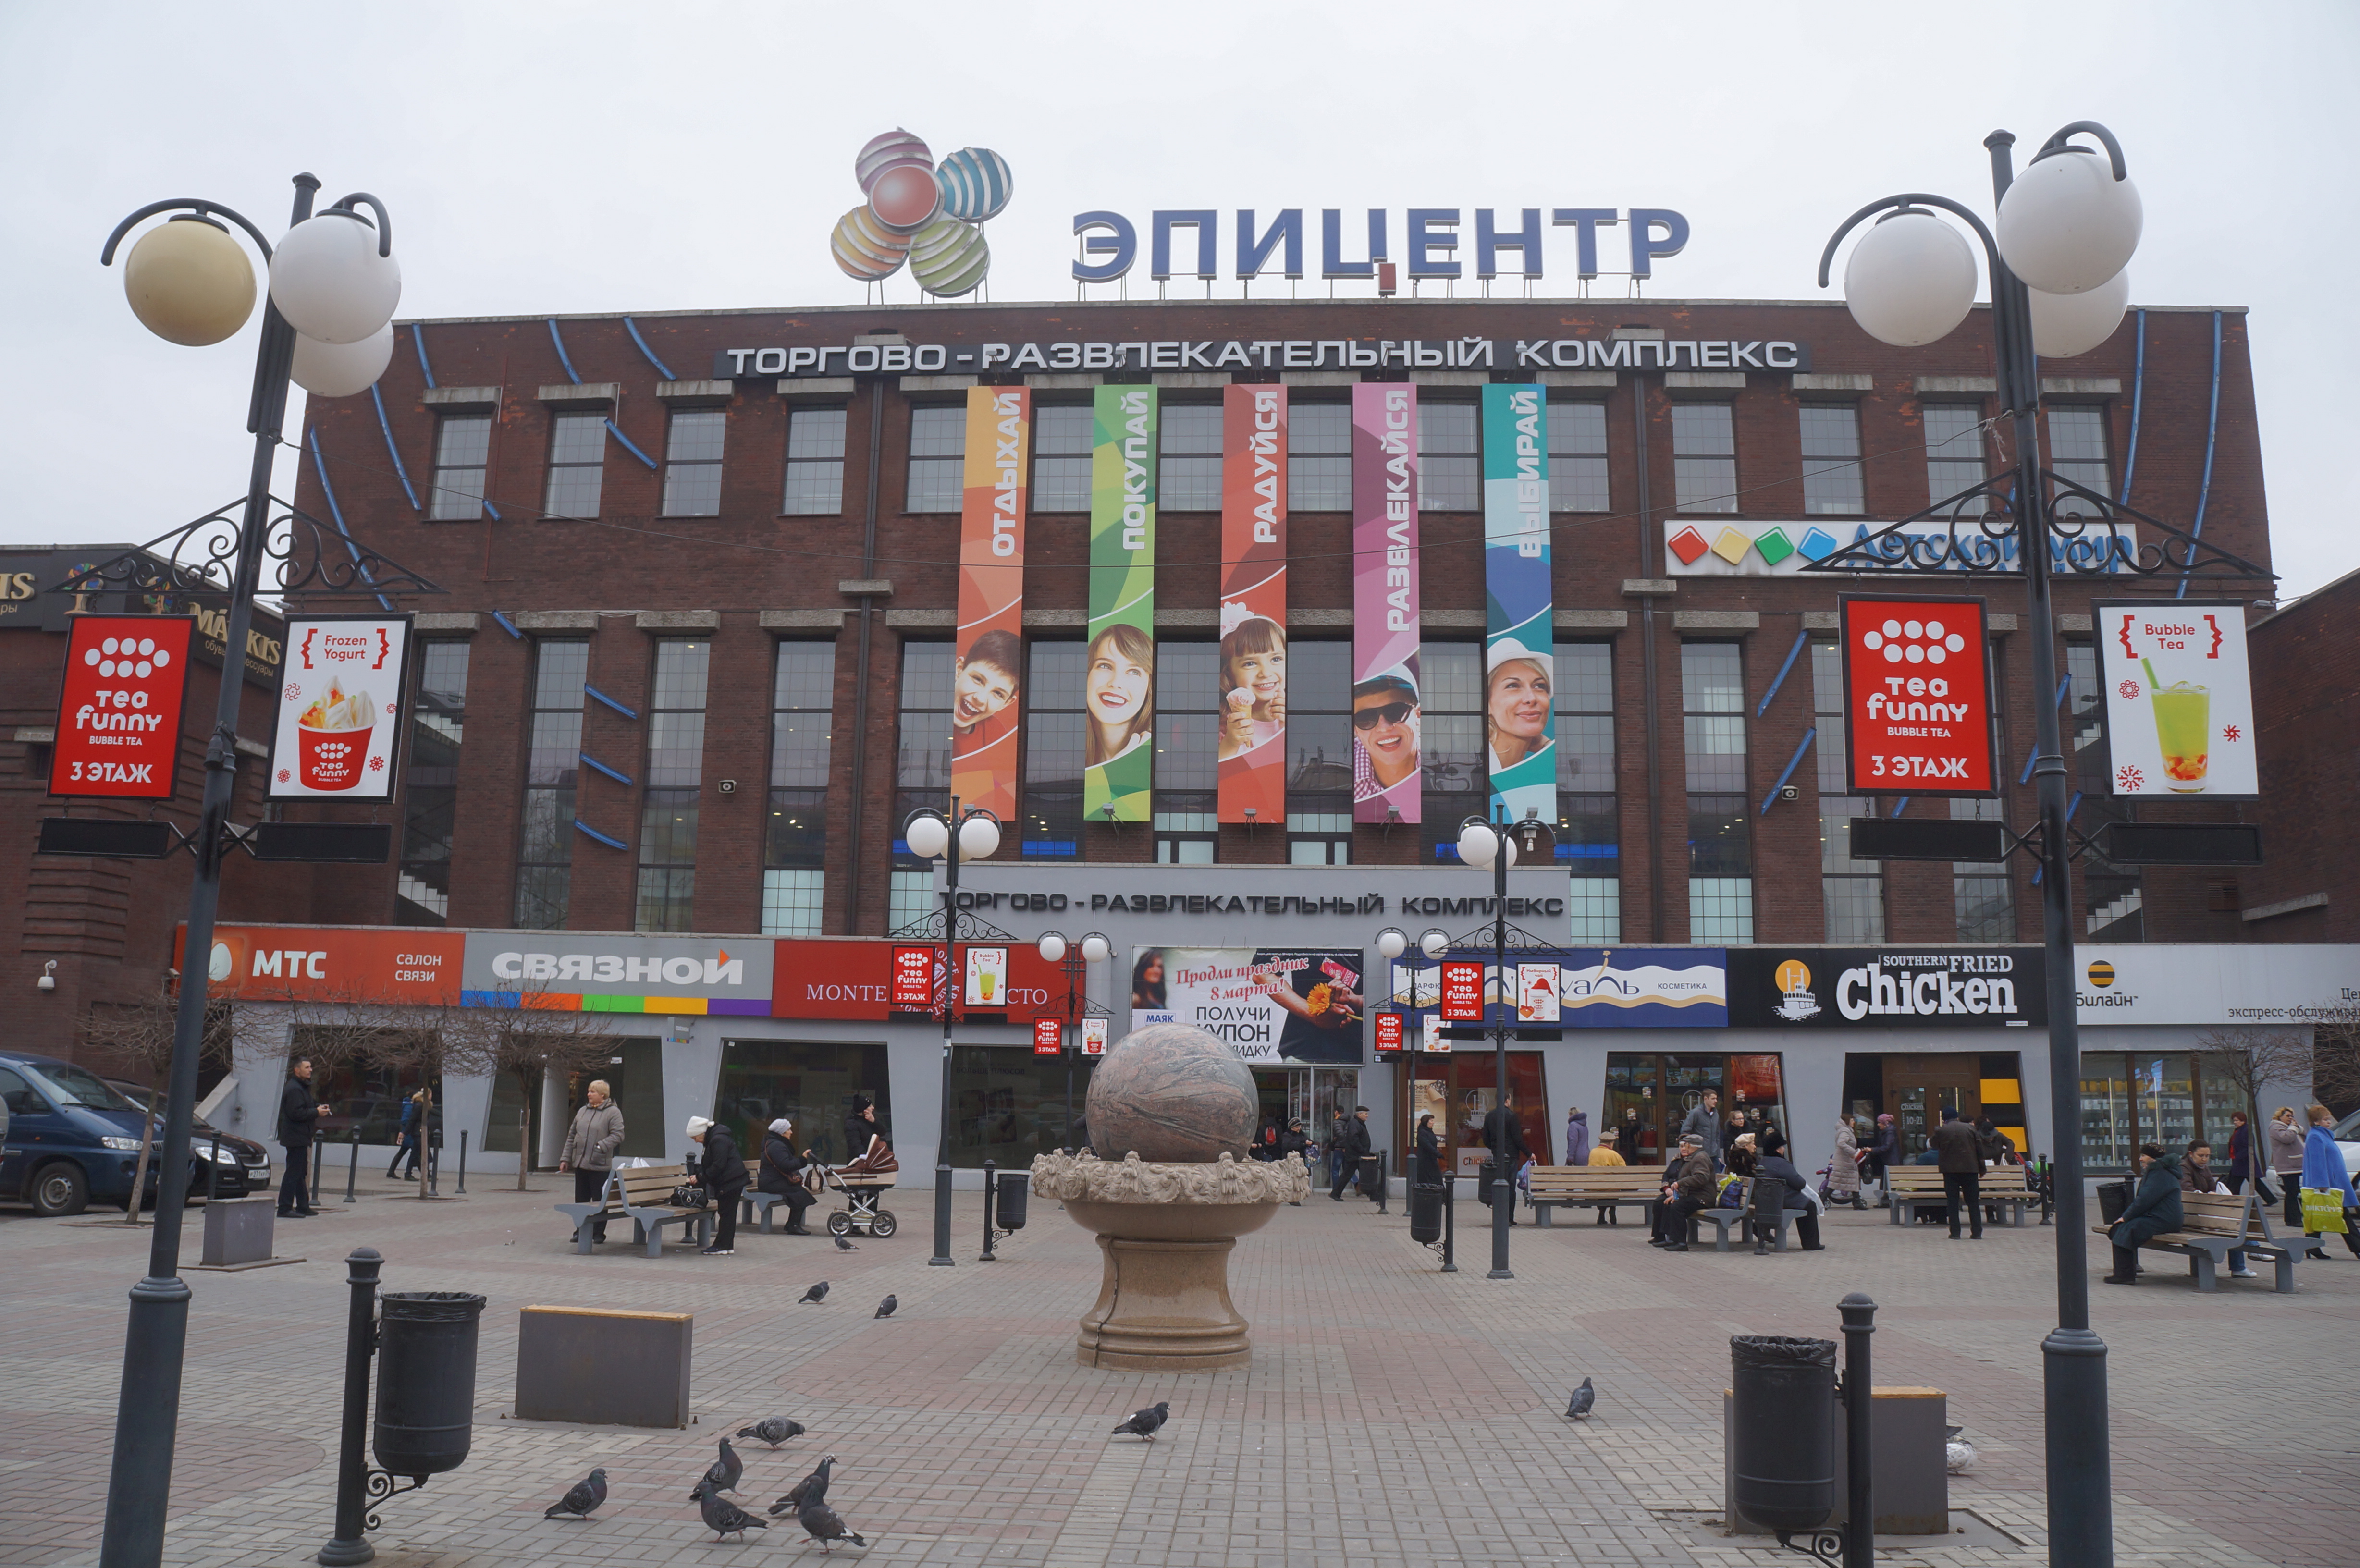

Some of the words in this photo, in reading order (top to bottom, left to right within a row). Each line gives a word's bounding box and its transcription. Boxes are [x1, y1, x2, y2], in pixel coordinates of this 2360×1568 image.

[1072, 208, 1690, 295] ЭПИЦЕНТР
[727, 344, 946, 375] ТОРГОВО
[1517, 340, 1798, 368] КОМПЛЕКС
[992, 392, 1021, 556] ОТДЫХАЙ
[1120, 392, 1148, 550] ПОКУПАЙ
[1249, 391, 1278, 543] РАДУЙСЯ
[1510, 391, 1541, 558] ВЫБИРАЙ
[1380, 390, 1410, 632] РАЗВЛЕКАЙСЯ
[189, 601, 281, 666] MÁKIS
[2145, 624, 2196, 636] Bubble
[324, 635, 367, 647] Frozen
[2158, 638, 2185, 650] Tea
[323, 648, 366, 662] Yogurt
[245, 658, 274, 678] ессуары
[1885, 677, 1948, 698] Tea
[96, 690, 148, 709] Tea
[1867, 692, 1968, 722] funny
[76, 705, 162, 732] funny
[89, 735, 124, 746] BUBBLE
[126, 736, 143, 746] TEA
[1887, 727, 1928, 737] BUBBLE
[1931, 728, 1951, 738] TEA
[70, 762, 83, 781] 3
[87, 762, 152, 784] ЭТАЖ
[312, 766, 350, 777] funny
[1871, 756, 1885, 777] 3
[1891, 756, 1969, 778] ЭТАЖ
[1091, 891, 1384, 914] РАЗВЛЕКАТЕЛЬНЫЙ
[1402, 897, 1563, 914] КОМПЛЕКС
[252, 950, 327, 979] МТС
[396, 953, 442, 967] салон
[492, 949, 743, 985] СВЯЗНОЙ
[1883, 956, 1947, 967] SOUTHERN
[1950, 955, 2013, 973] FRIED
[897, 975, 927, 984] funny
[1176, 965, 1232, 988] Продли
[1237, 956, 1310, 981] праздник
[807, 984, 887, 1001] MONTE
[1007, 988, 1047, 1004] СТО
[1210, 987, 1219, 1000] 8
[1223, 979, 1284, 1002] марта!
[1447, 991, 1478, 1000] funny
[1836, 963, 2017, 1020] Chicken
[2076, 992, 2133, 1006] Билайн
[1146, 1015, 1174, 1023] МАЯК
[1197, 1006, 1270, 1021] ПОЛУЧИ
[1197, 1024, 1270, 1042] УПОН
[1233, 1045, 1271, 1058] ИДКУ
